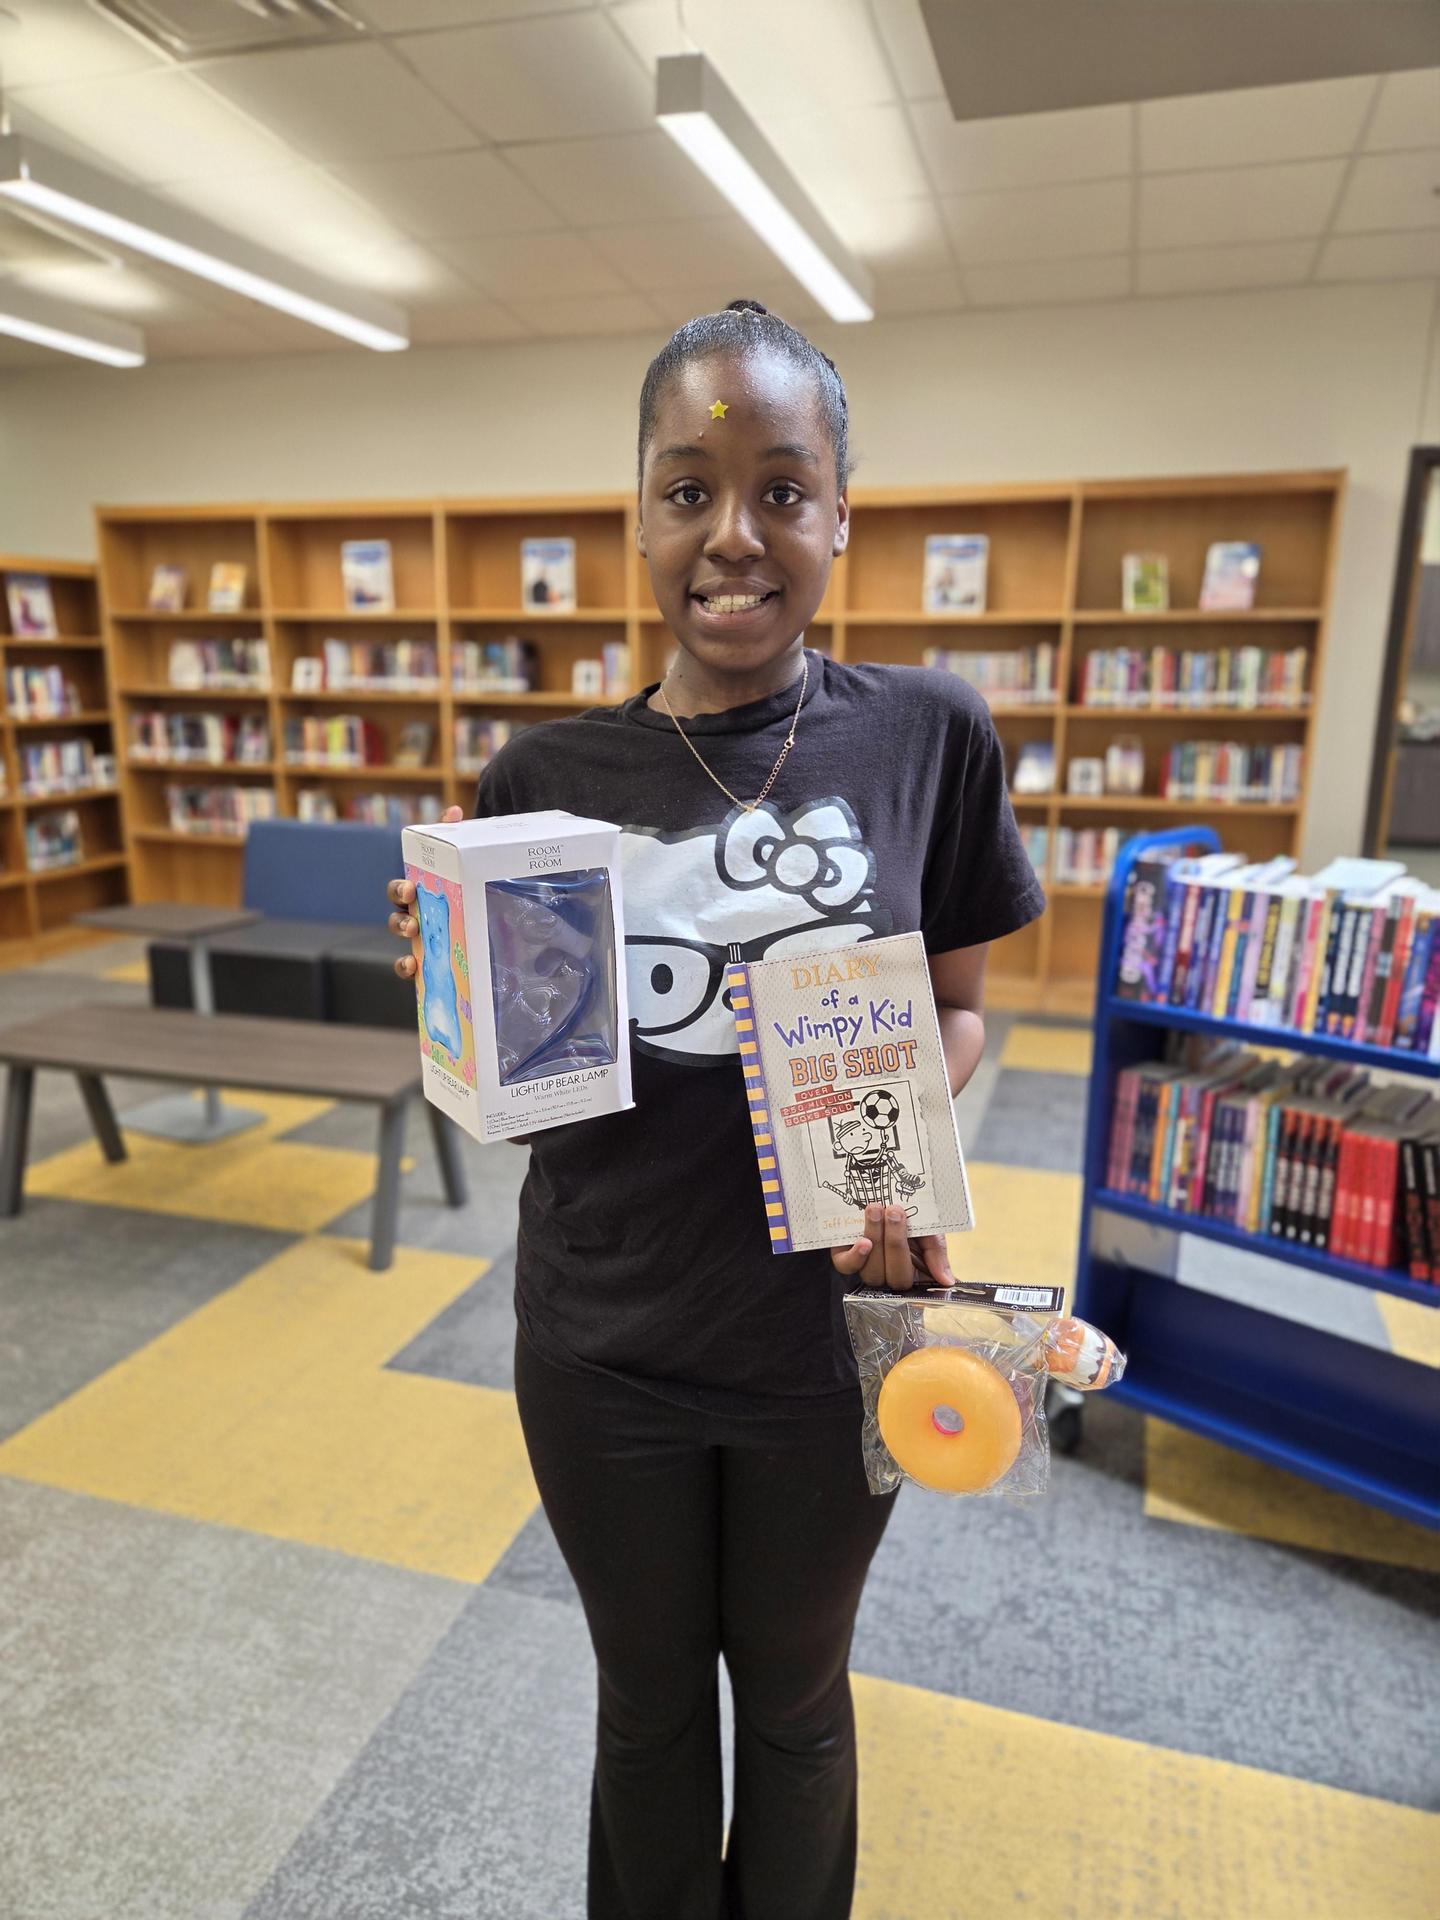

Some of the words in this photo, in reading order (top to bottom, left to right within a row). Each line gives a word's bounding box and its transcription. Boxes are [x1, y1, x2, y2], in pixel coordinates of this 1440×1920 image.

[528, 845, 561, 857] ROOM
[529, 858, 562, 870] ROOM
[790, 953, 880, 991] DIARY
[821, 989, 839, 1009] of
[848, 995, 859, 1006] a
[773, 1015, 863, 1049] Wimpy
[869, 998, 912, 1034] Kid
[789, 1053, 838, 1087] BIG
[842, 1039, 917, 1078] SHOT
[510, 1082, 540, 1098] LIGHT
[541, 1079, 555, 1092] UP
[556, 1073, 581, 1088] BEAR
[581, 1068, 609, 1082] LAMP
[800, 1087, 829, 1100] OVER
[534, 1092, 554, 1101] Warm
[783, 1104, 805, 1116] 250
[807, 1091, 852, 1111] MILLION
[786, 1110, 821, 1126] BOOKS
[824, 1103, 853, 1117] SOLD
